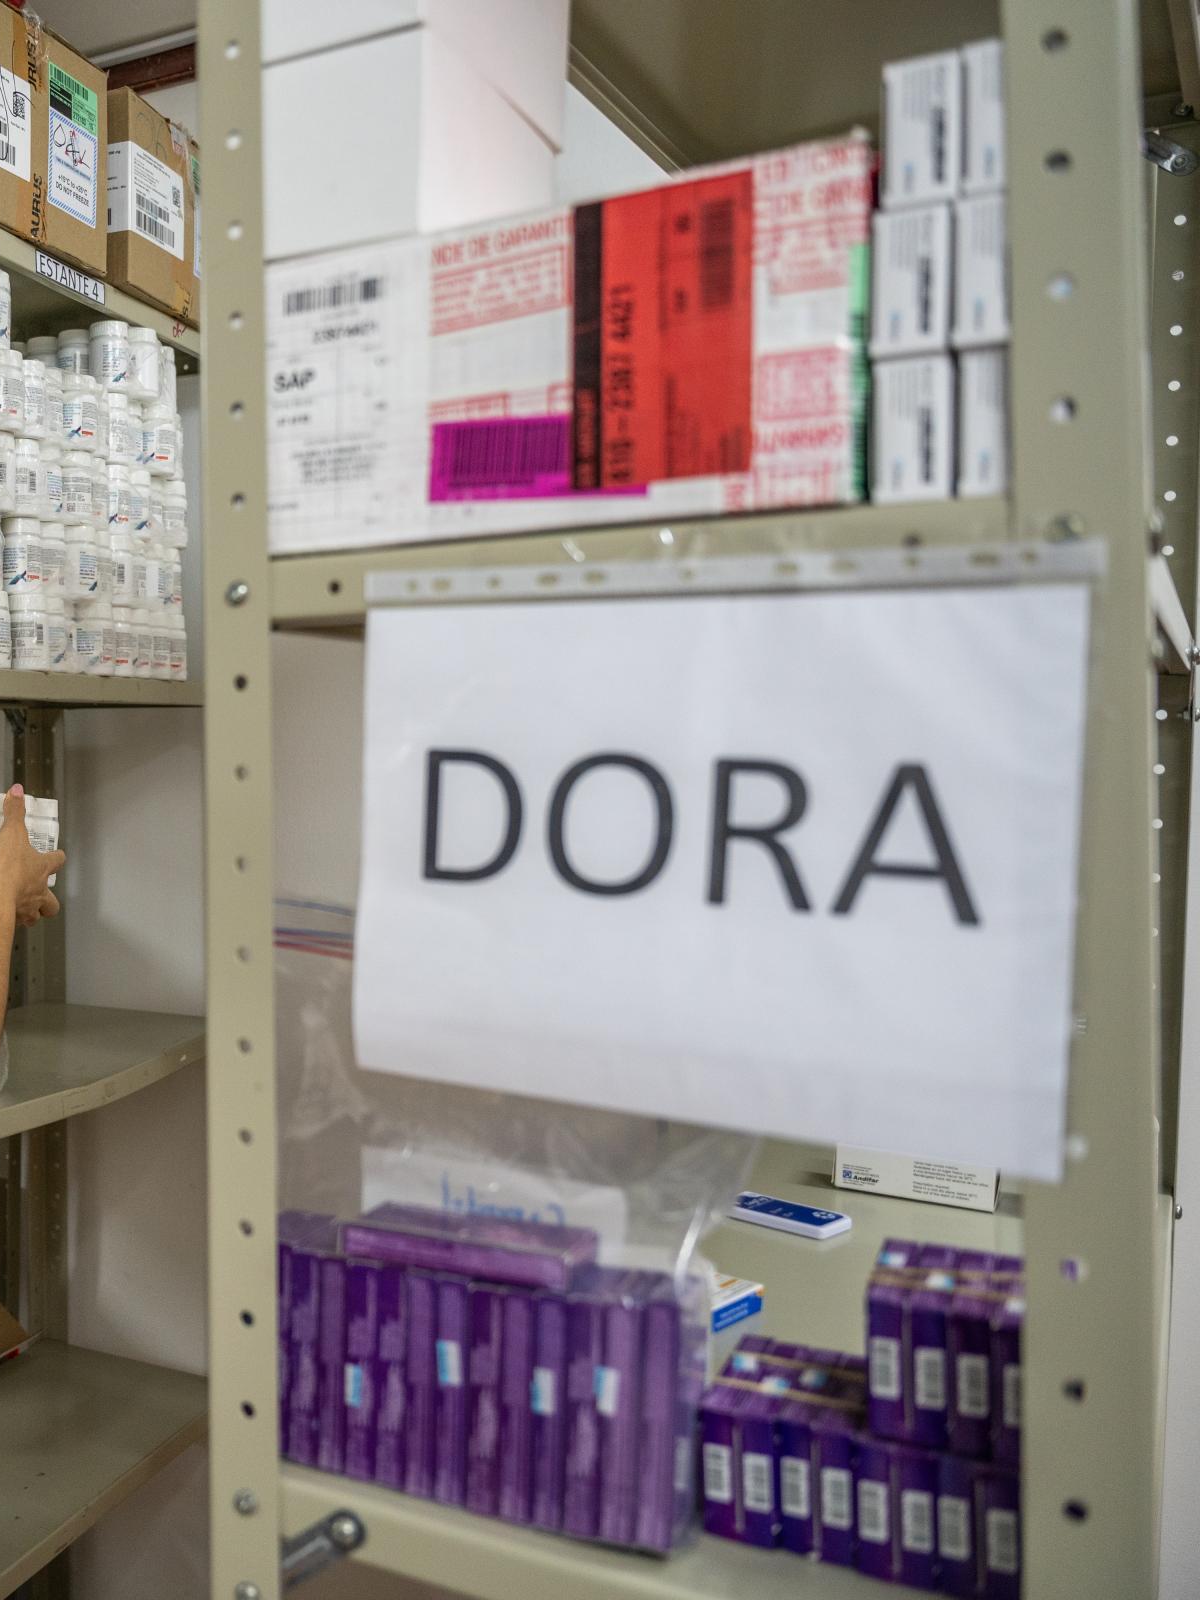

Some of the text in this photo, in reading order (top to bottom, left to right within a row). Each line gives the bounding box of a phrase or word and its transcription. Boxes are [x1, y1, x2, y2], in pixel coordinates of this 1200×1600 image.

[30, 173, 42, 238] AURUS
[40, 254, 99, 300] ESTANTE 4
[273, 368, 316, 393] SAP
[421, 748, 980, 928] DORA
